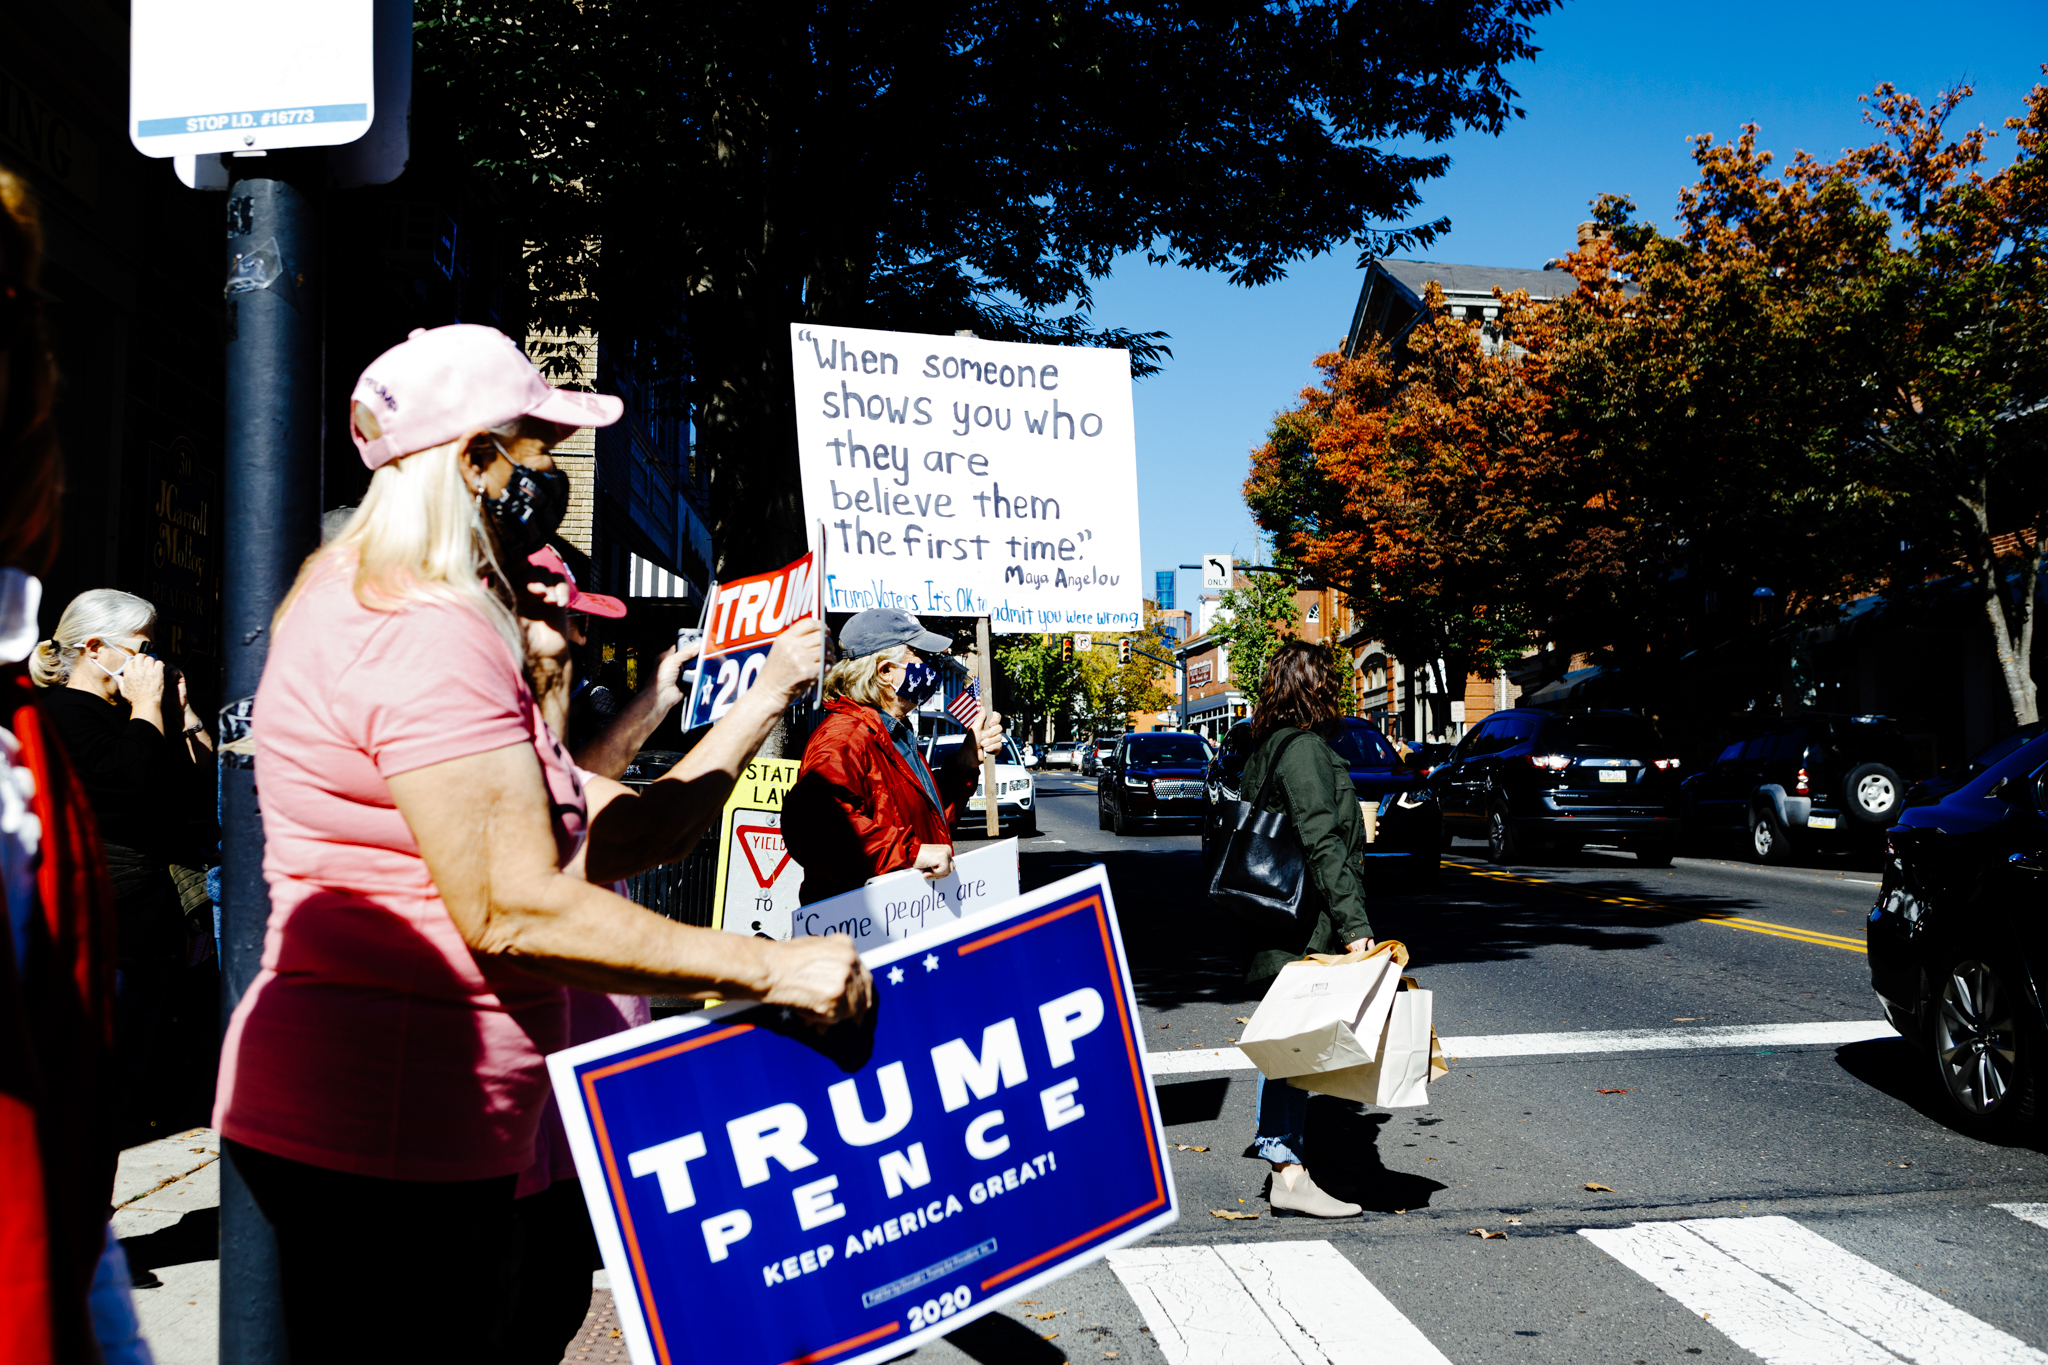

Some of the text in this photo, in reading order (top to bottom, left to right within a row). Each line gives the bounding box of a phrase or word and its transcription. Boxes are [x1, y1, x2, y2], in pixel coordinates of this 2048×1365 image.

[186, 109, 315, 132] STOP I.D. #16773
[797, 328, 1059, 391] “When someone
[822, 380, 1103, 441] shows you who
[826, 429, 989, 486] they are
[829, 477, 1061, 520] believe them
[153, 522, 206, 587] Molloy
[834, 514, 896, 556] the
[903, 523, 991, 561] first
[152, 581, 204, 616] REALTOR
[715, 561, 813, 645] TRUM
[826, 574, 873, 611] Trump
[924, 580, 951, 612] It's
[956, 587, 976, 612] OK
[977, 596, 988, 612] to
[991, 599, 1034, 625] admit
[1038, 609, 1062, 632] you
[1004, 564, 1120, 592] Maya Angelou
[1207, 578, 1229, 586] ONLY
[752, 835, 787, 851] YIELD
[755, 897, 773, 912] TO
[884, 880, 946, 936] people
[956, 879, 986, 902] are
[627, 986, 1106, 1214] TRUMP
[699, 1077, 1087, 1264] PENCE
[763, 1244, 835, 1287] KEEP
[844, 1195, 963, 1260] AMERICA
[969, 1151, 1058, 1206] GREAT!
[906, 1284, 972, 1333] 2020
